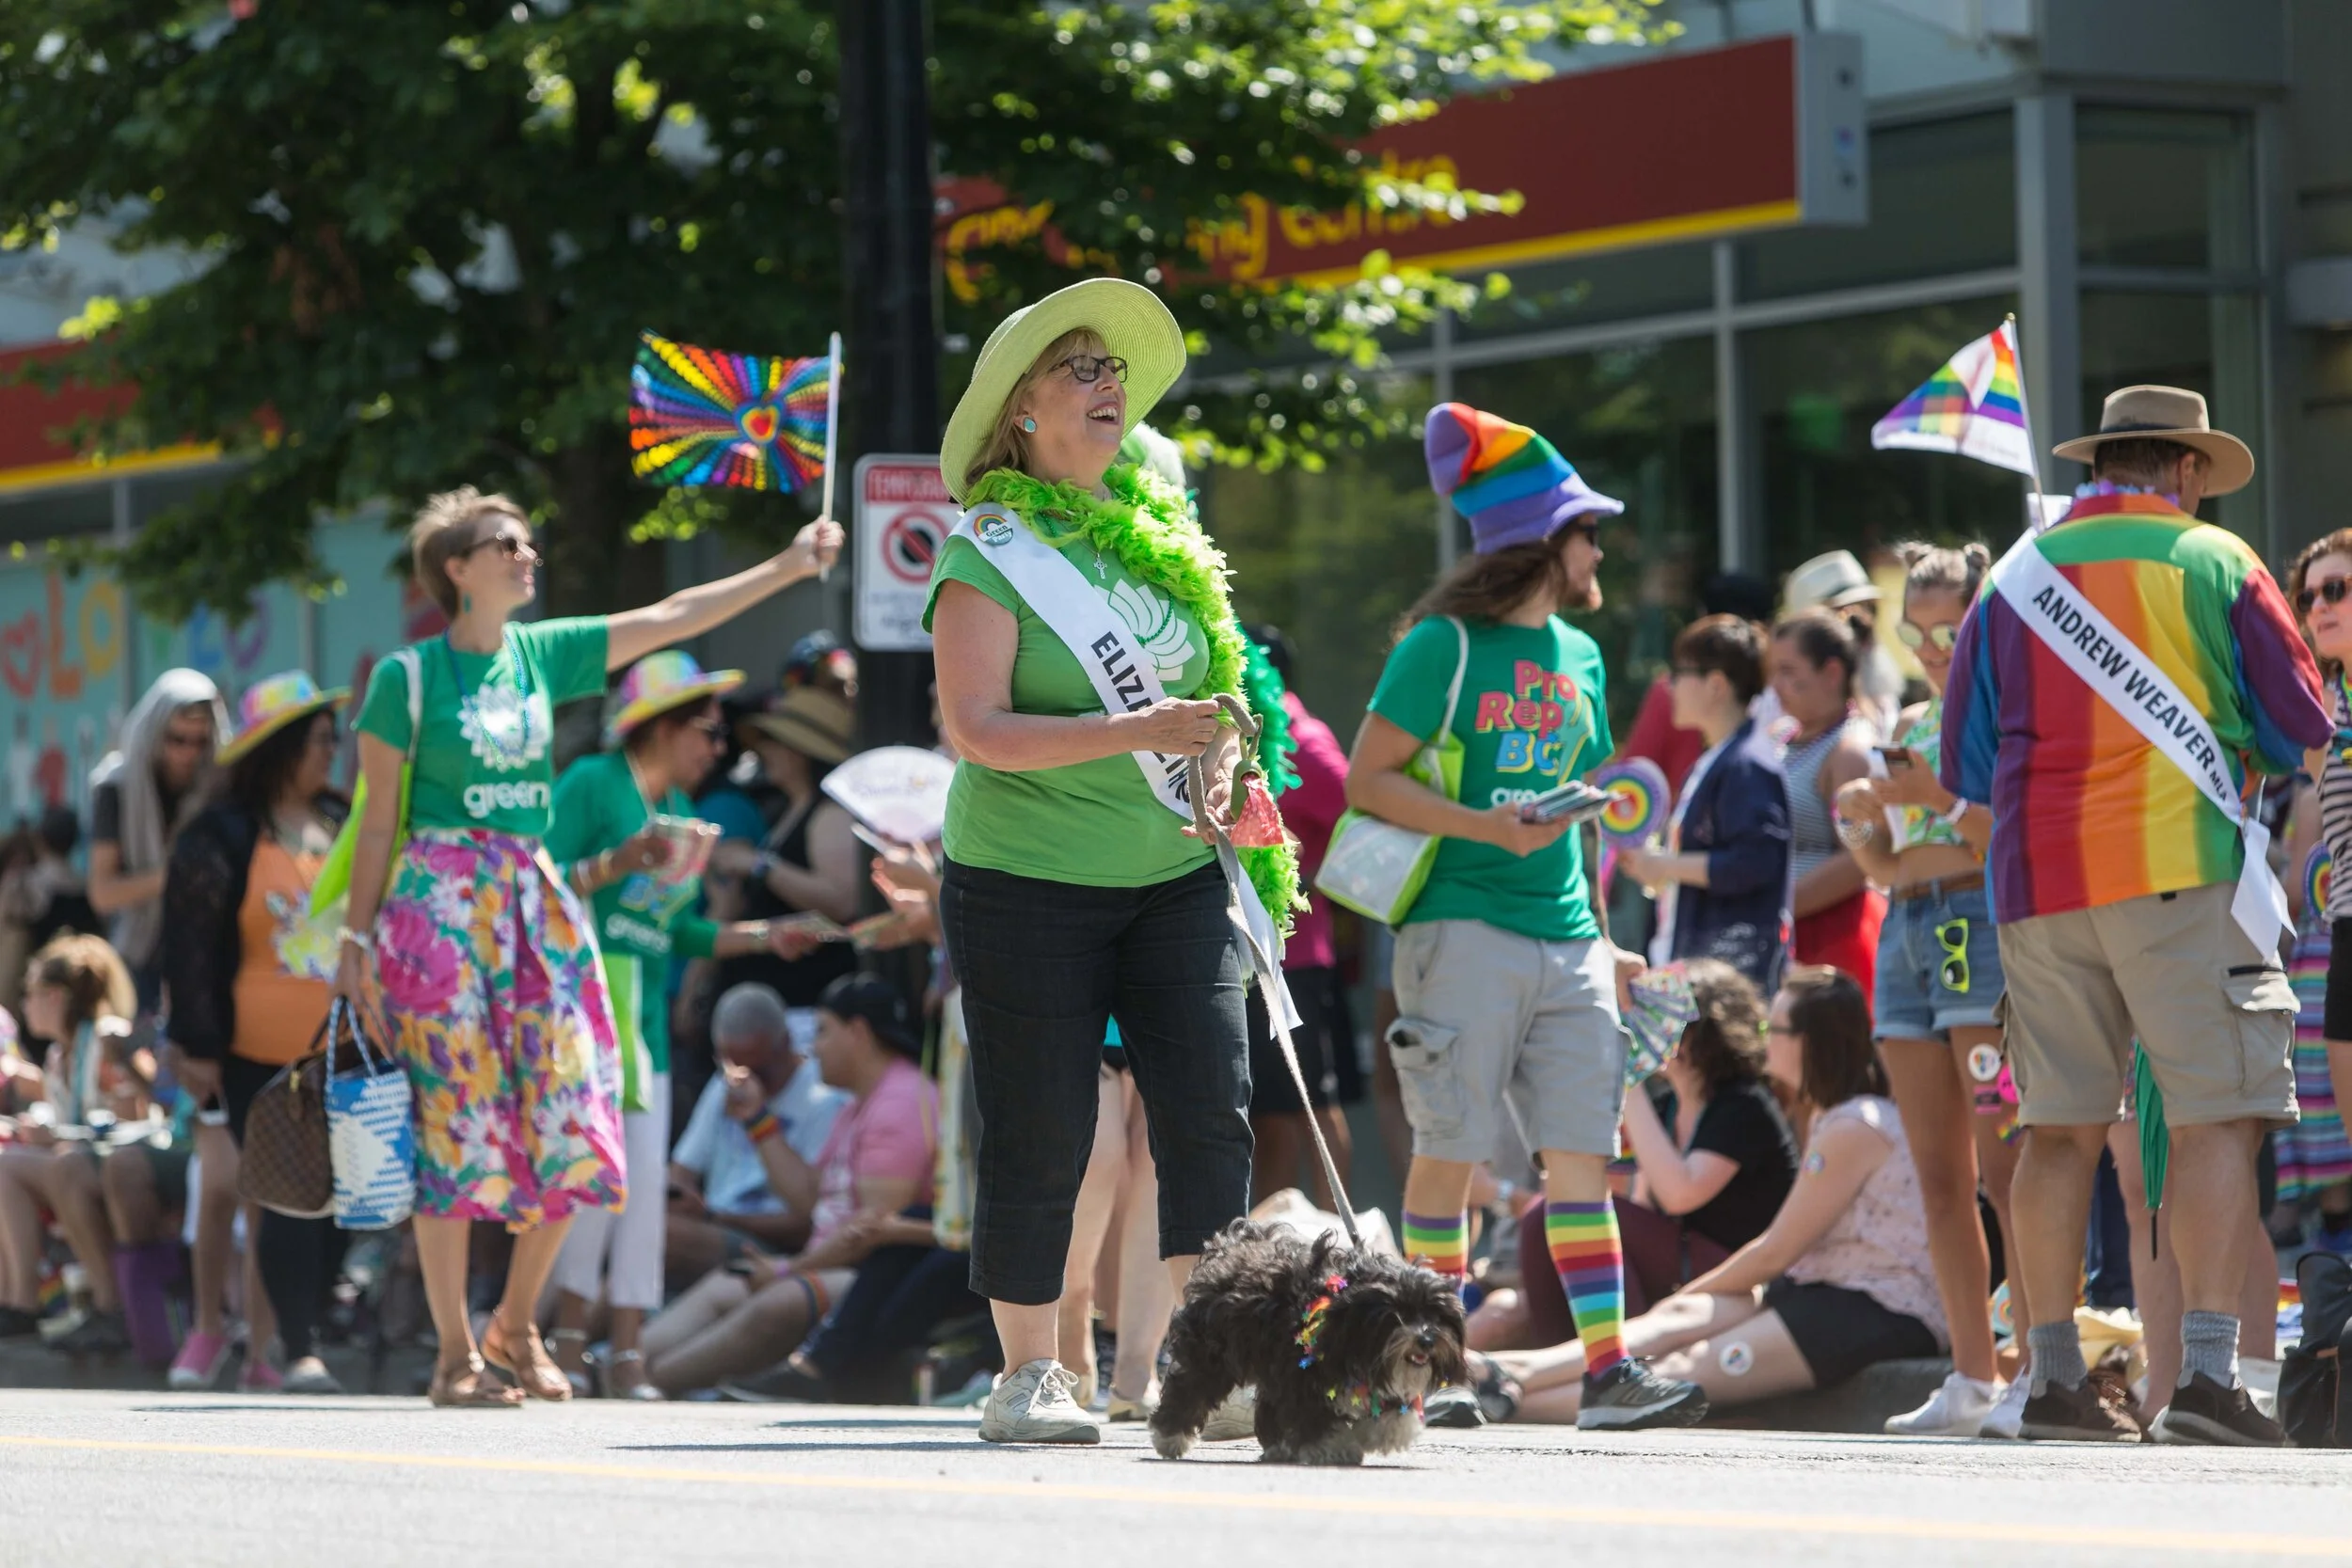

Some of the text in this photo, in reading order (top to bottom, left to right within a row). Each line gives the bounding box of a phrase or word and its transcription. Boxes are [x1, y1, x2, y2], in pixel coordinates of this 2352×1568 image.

[985, 524, 1009, 537] Green
[1514, 659, 1581, 702] Pro
[2032, 584, 2227, 801] ANDREW WEAVER MLA
[1474, 691, 1565, 741] Rep
[1494, 732, 1563, 777] BC
